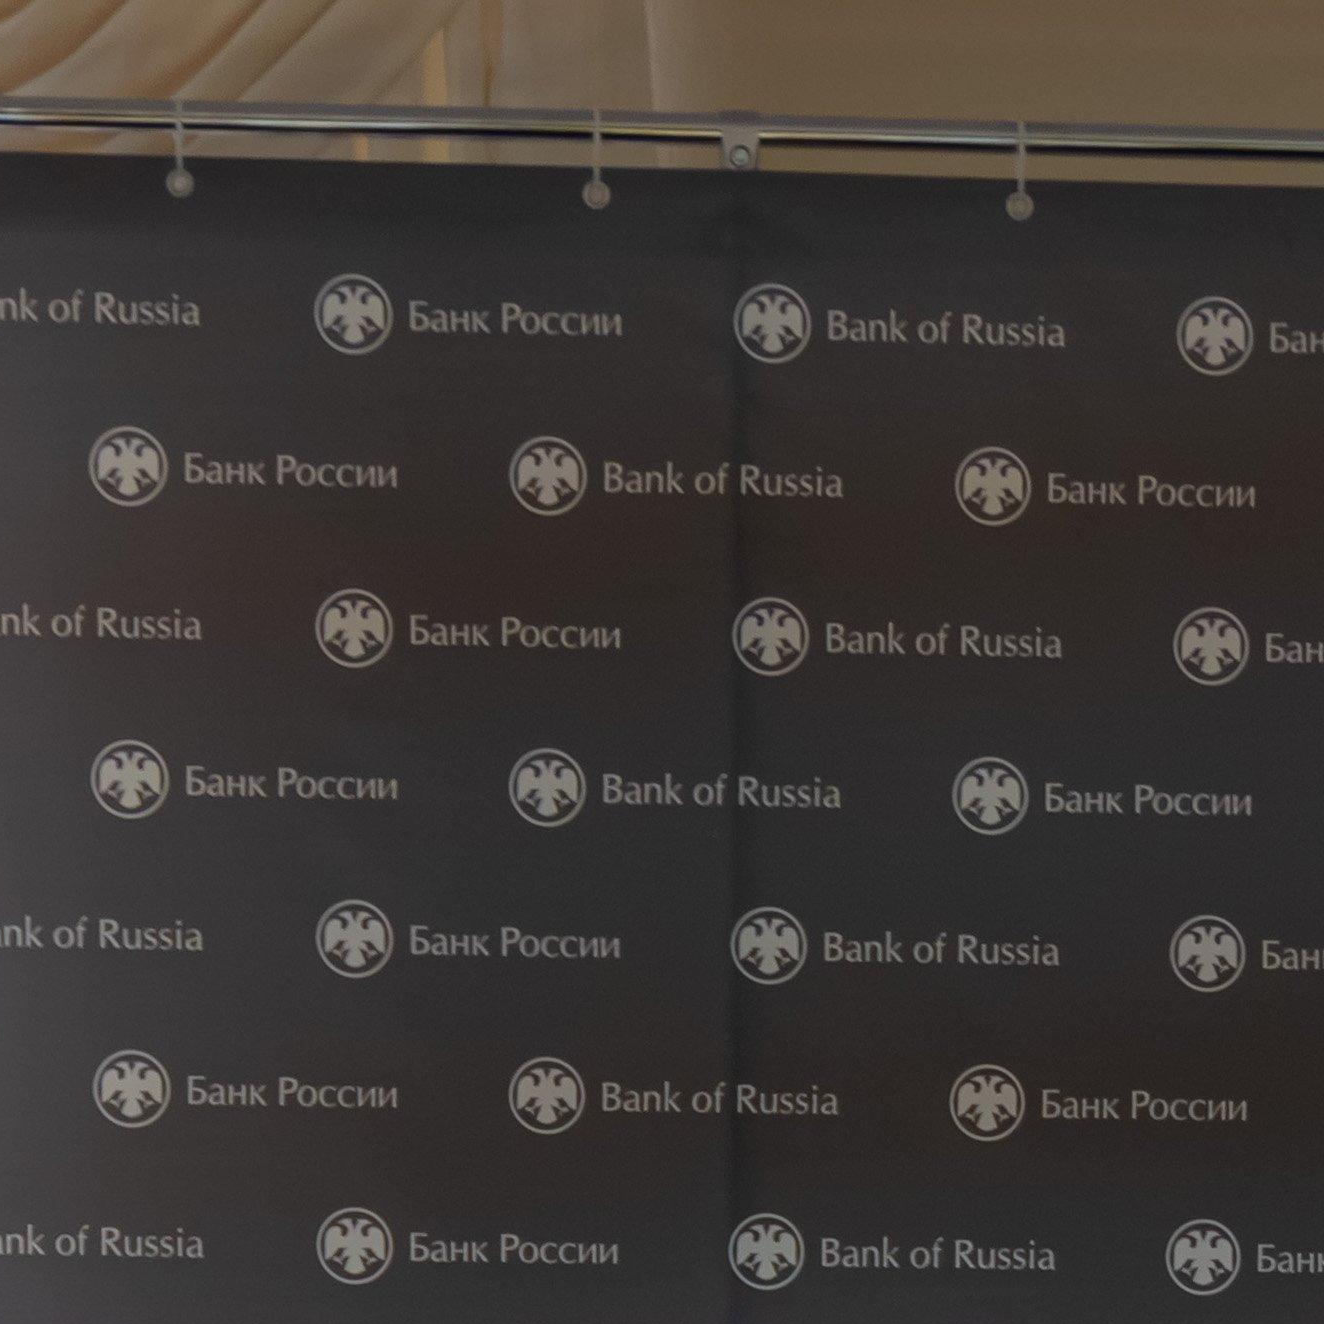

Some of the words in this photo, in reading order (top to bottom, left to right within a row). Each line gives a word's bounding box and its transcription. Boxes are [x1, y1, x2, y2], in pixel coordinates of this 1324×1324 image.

[47, 288, 84, 323] of
[94, 291, 200, 326] Russia
[408, 299, 491, 334] Банк
[501, 302, 623, 337] России
[827, 308, 907, 343] Bank
[917, 311, 953, 344] of
[962, 313, 1066, 348] Russia
[183, 451, 266, 485] Банк
[276, 454, 398, 488] России
[603, 461, 685, 494] Bank
[694, 462, 730, 495] of
[740, 464, 844, 498] Russia
[185, 764, 267, 798] Банк
[277, 766, 398, 800] России
[409, 924, 490, 957] Банк
[500, 926, 621, 959] России
[601, 1080, 682, 1113] Bank
[691, 1081, 727, 1114] of
[736, 1083, 839, 1116] Russia
[1041, 1088, 1120, 1120] Банк
[1131, 1089, 1248, 1122] России
